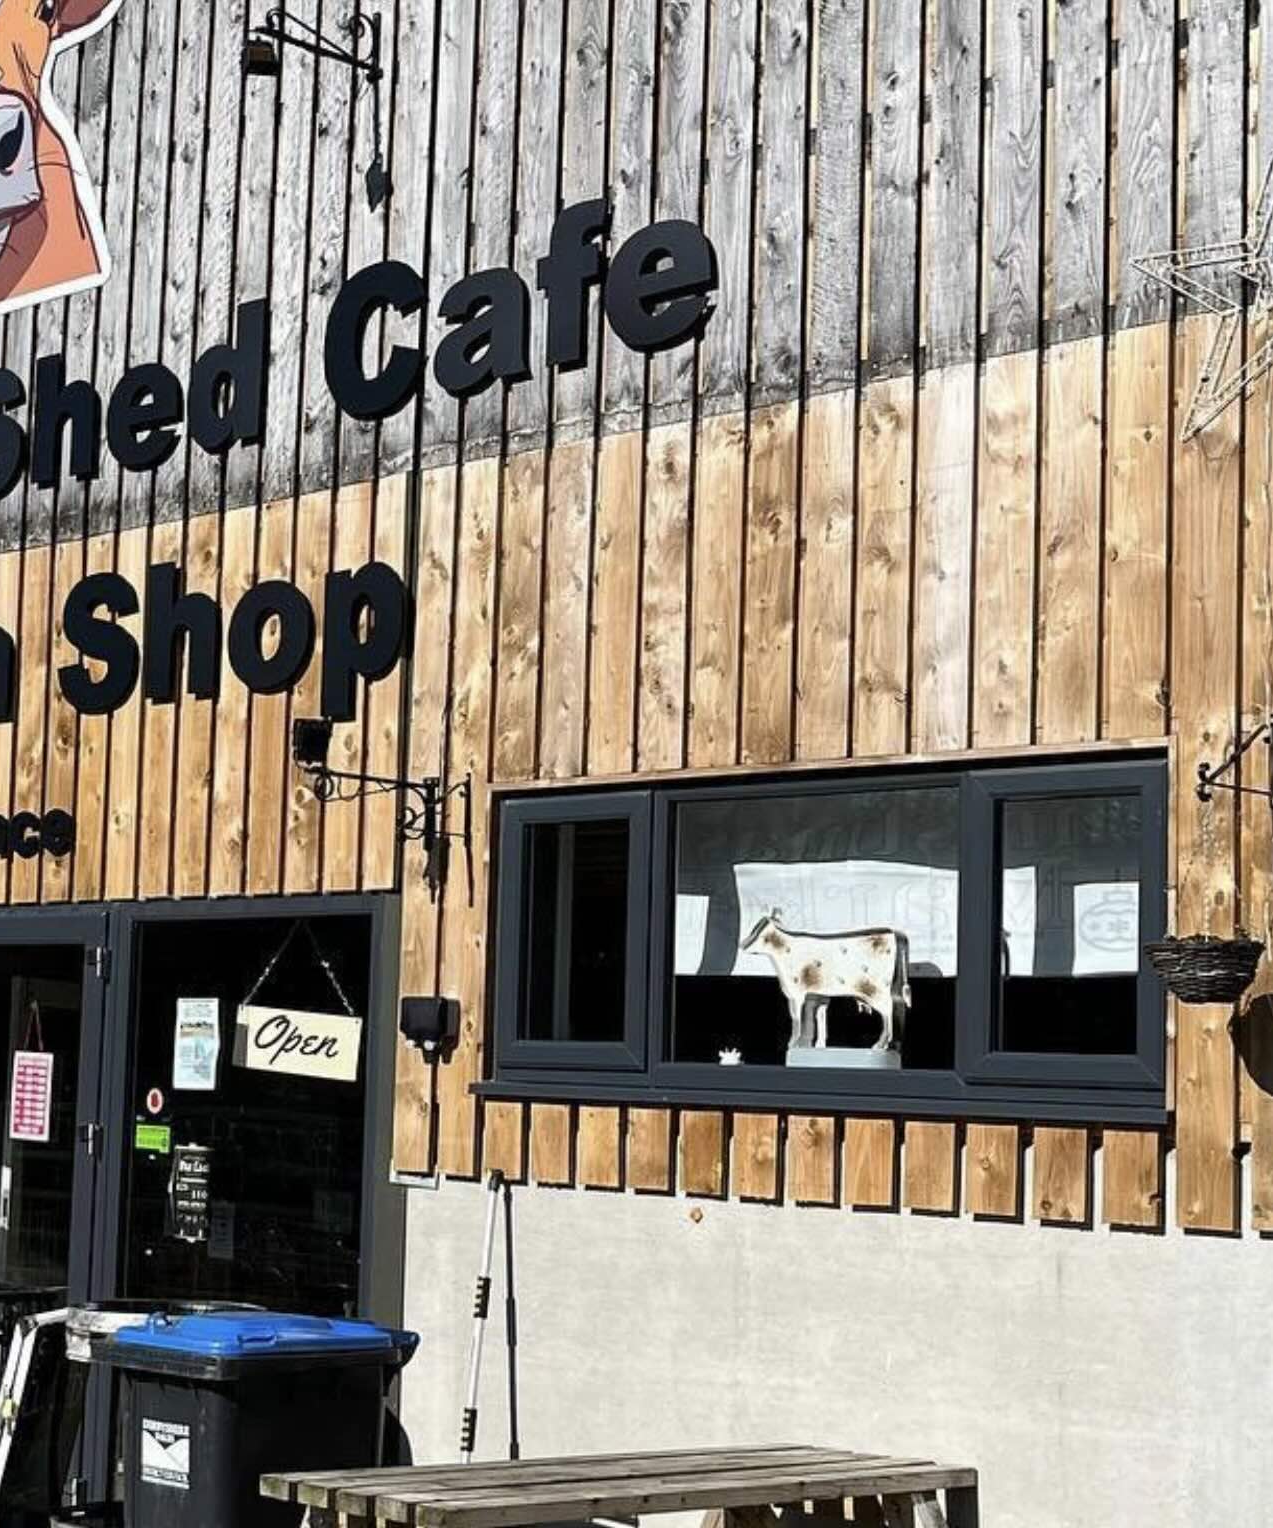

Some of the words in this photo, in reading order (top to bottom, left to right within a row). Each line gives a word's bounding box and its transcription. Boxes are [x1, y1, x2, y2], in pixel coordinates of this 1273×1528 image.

[322, 197, 720, 421] Cafe
[58, 560, 409, 721] Shop
[254, 1014, 340, 1066] Open
